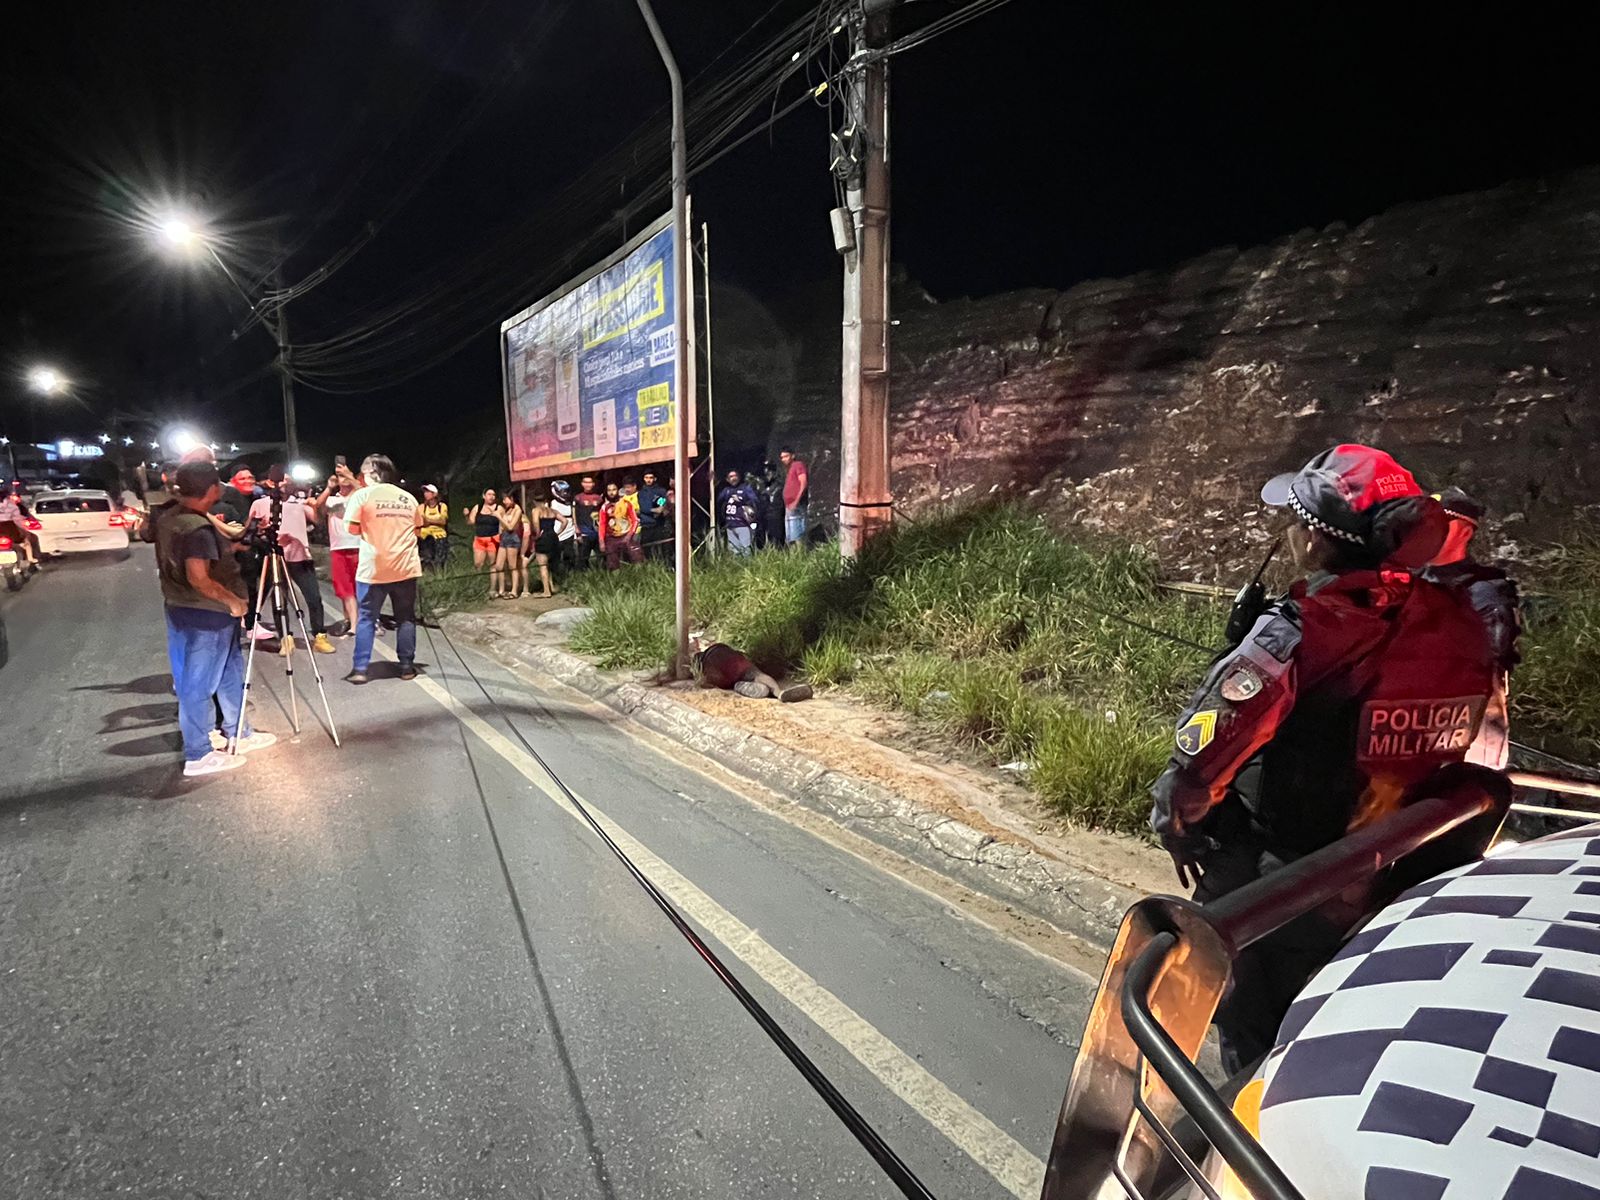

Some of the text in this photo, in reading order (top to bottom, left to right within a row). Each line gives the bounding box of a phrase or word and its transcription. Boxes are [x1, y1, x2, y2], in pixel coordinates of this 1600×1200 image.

[725, 504, 737, 515] 26
[1370, 704, 1471, 731] POLÍCIA
[1368, 728, 1470, 756] MILITAR
